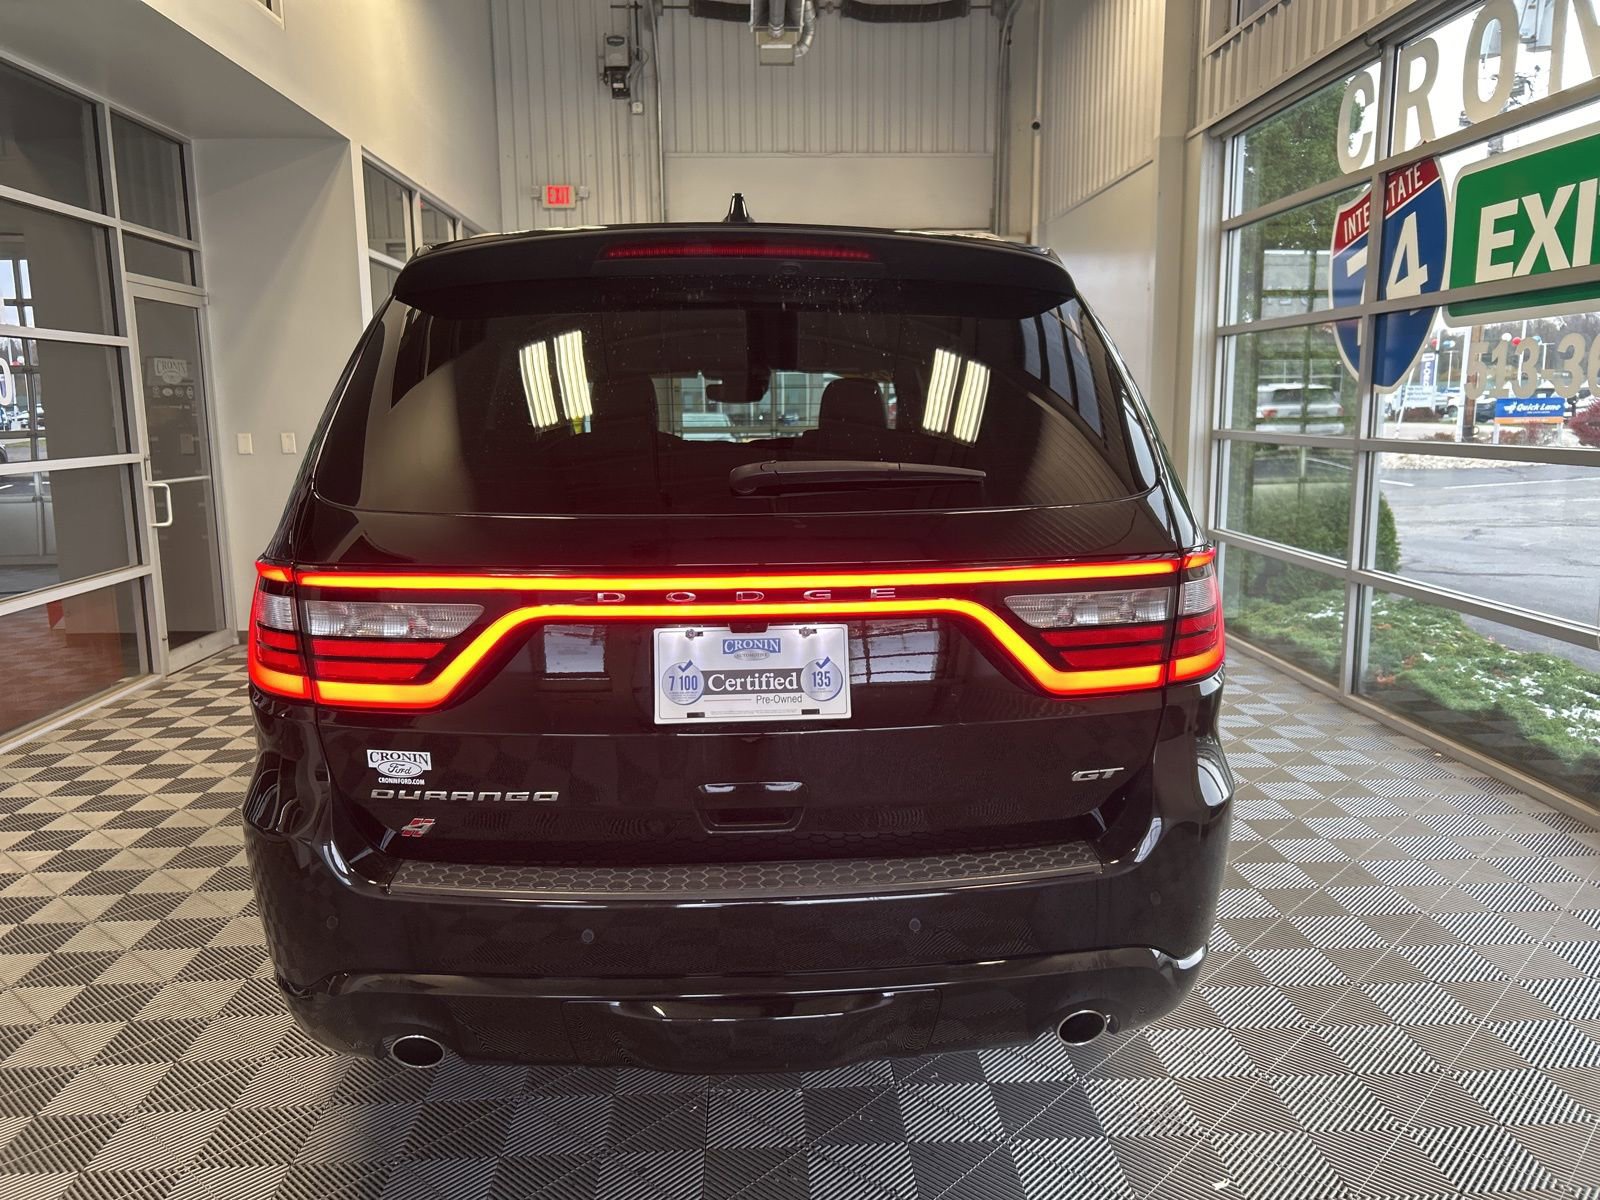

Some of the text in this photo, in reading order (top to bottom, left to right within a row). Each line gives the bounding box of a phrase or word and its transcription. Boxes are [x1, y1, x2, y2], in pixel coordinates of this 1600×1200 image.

[547, 185, 570, 205] EXIT
[1343, 162, 1423, 243] INTETATE
[1475, 178, 1600, 284] EXI
[1516, 403, 1561, 412] Quick Lane
[596, 587, 896, 602] DODGE
[723, 639, 780, 653] CRONIN
[679, 675, 698, 691] 100
[708, 672, 799, 692] Certified
[812, 671, 831, 687] 135
[756, 695, 803, 705] Pre-Owned
[369, 751, 429, 767] CRONIN
[388, 762, 412, 775] Ford
[1072, 767, 1124, 781] GT
[378, 777, 425, 785] CRONINFORD.COM
[371, 789, 559, 801] DURANGO
